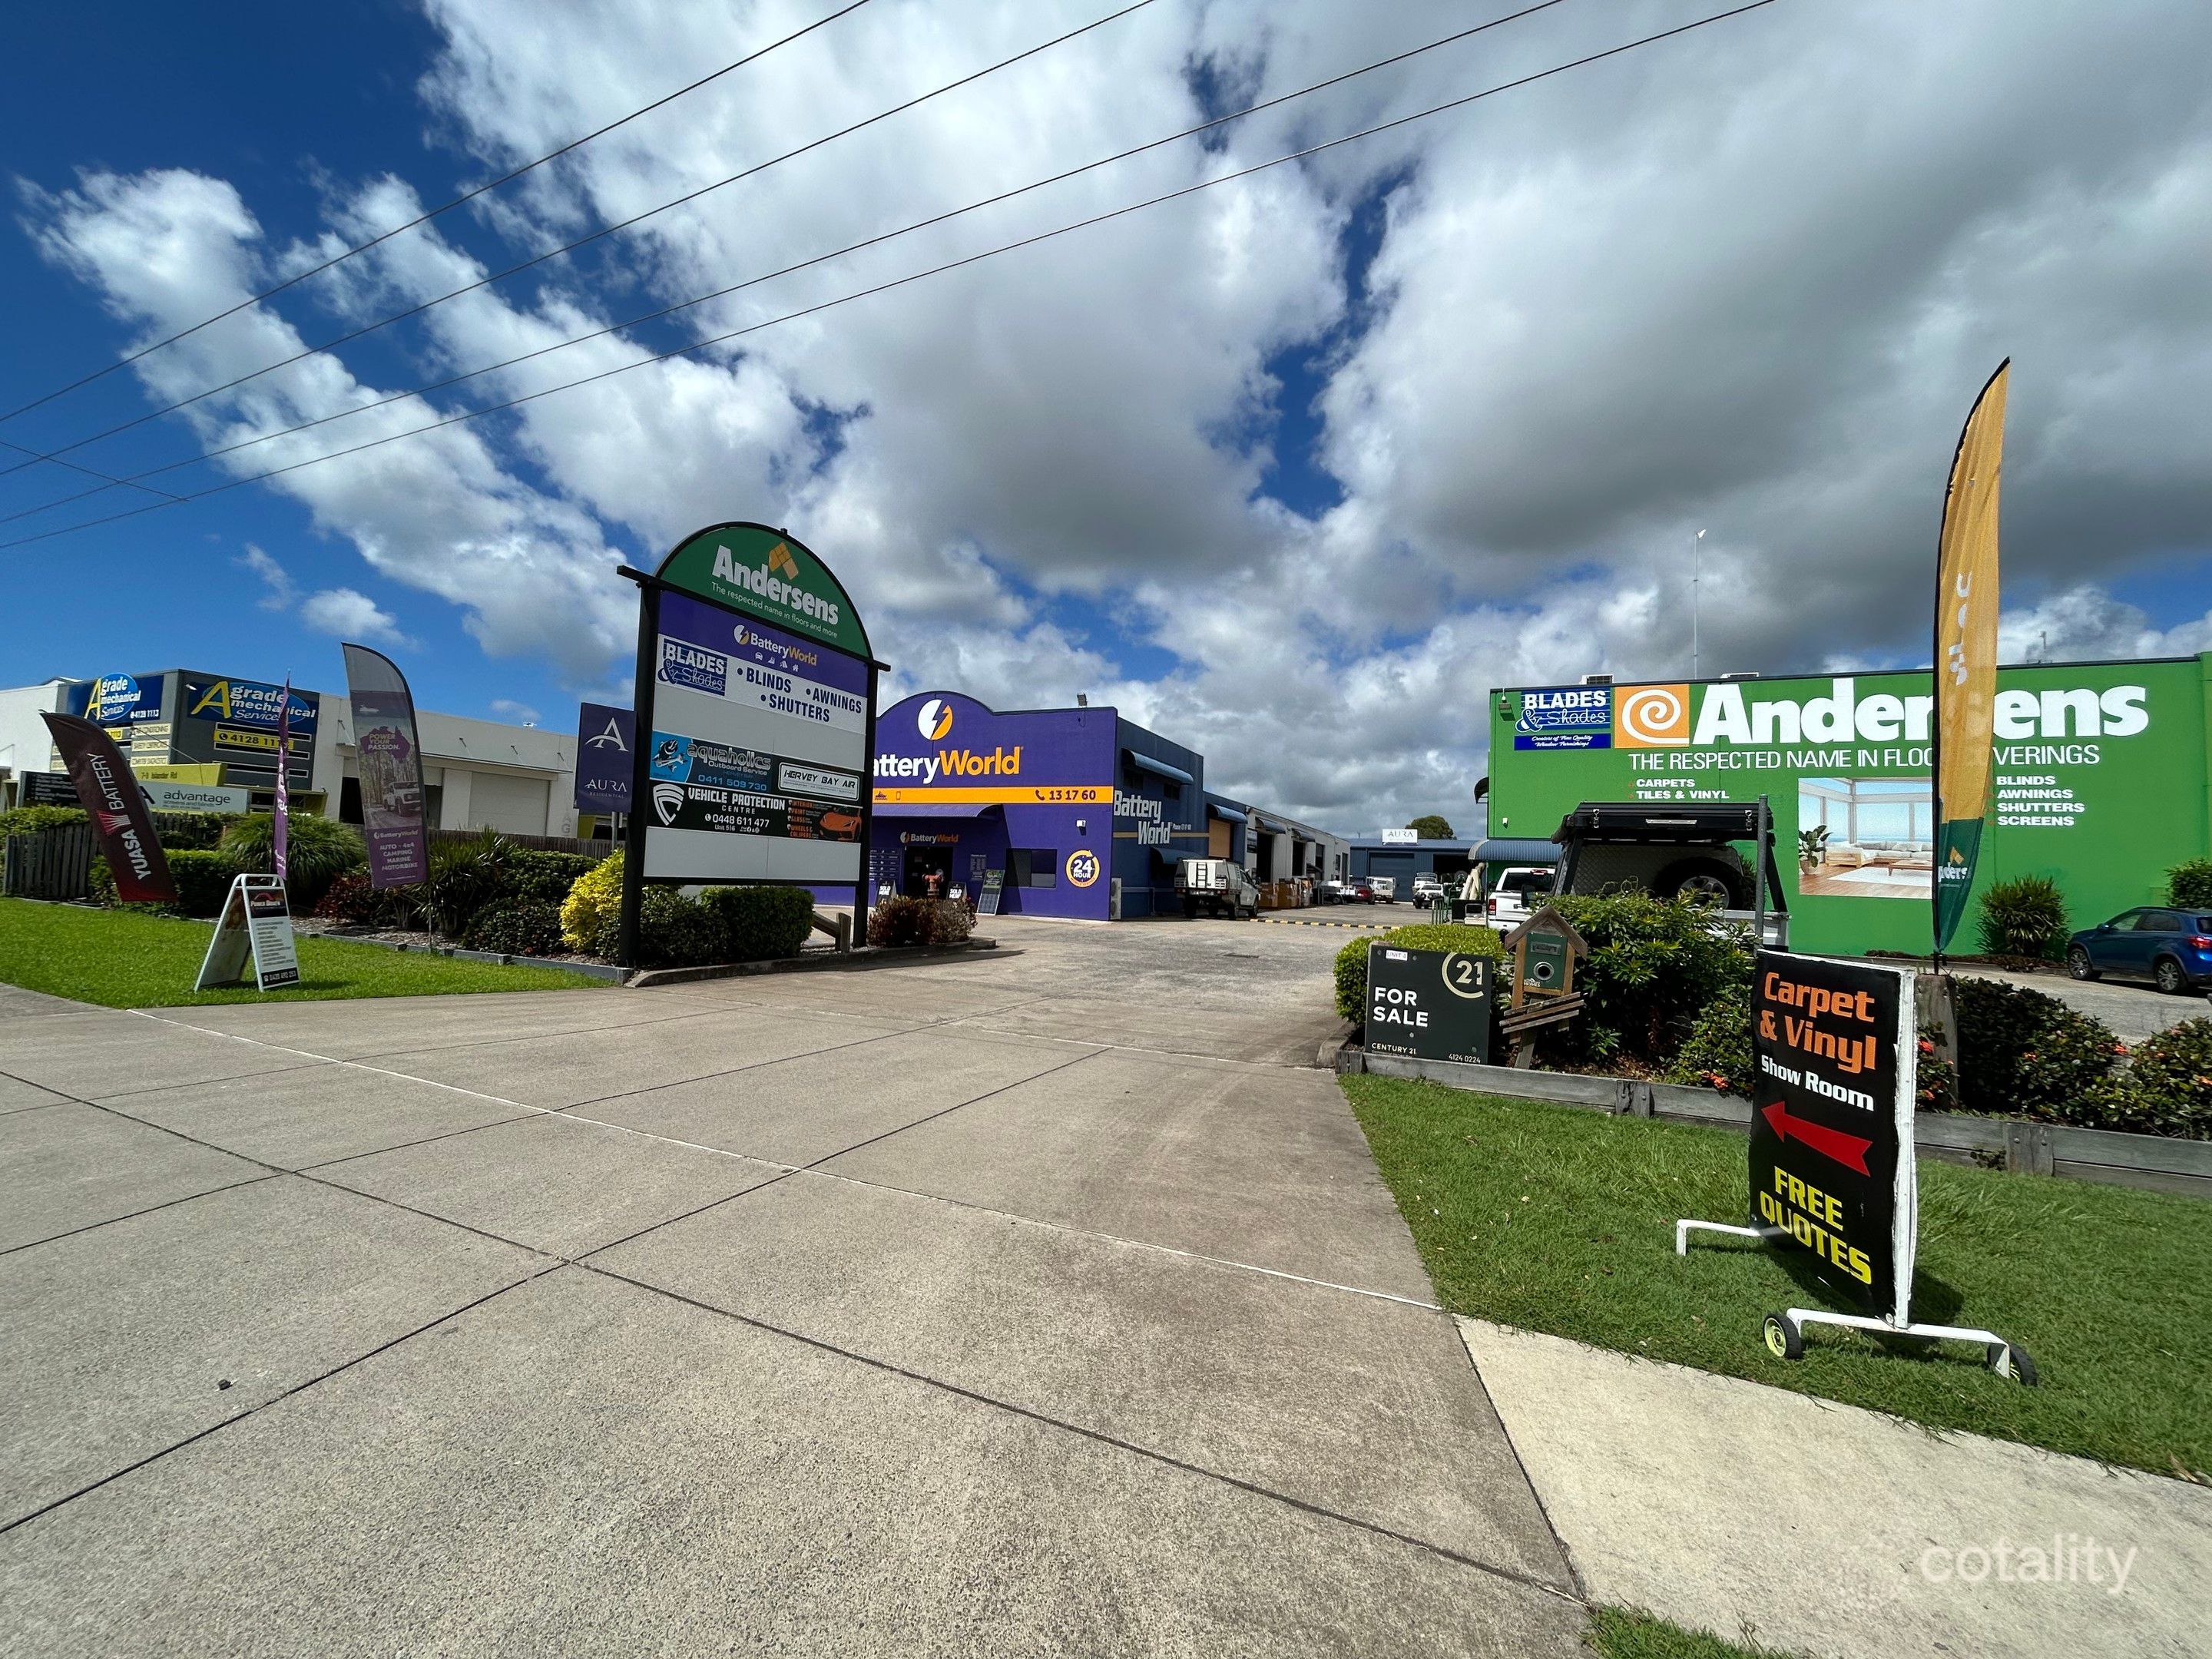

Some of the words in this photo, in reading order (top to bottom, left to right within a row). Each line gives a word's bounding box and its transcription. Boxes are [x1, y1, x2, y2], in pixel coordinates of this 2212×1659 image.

[712, 545, 839, 624] Andersens
[712, 581, 726, 594] The
[727, 591, 763, 609] respected
[764, 604, 783, 617] name
[783, 611, 790, 620] in
[791, 613, 809, 628] floors
[810, 621, 822, 632] and
[822, 628, 838, 638] more
[666, 643, 725, 675] BLADES
[101, 677, 128, 696] grade
[681, 667, 724, 690] Shades
[101, 690, 141, 704] mechanical
[230, 686, 285, 704] grade
[746, 667, 792, 693] BLINDS
[812, 687, 862, 714] AWNINGS
[1525, 690, 1607, 709] BLADES
[769, 694, 830, 722] SHUTTERS
[1692, 677, 2149, 744] Anderens
[1515, 708, 1543, 732] &
[1547, 708, 1607, 724] Shades
[231, 734, 259, 744] 4128
[687, 743, 771, 770] aquaholics
[1628, 753, 1664, 770] THE
[1670, 751, 1781, 770] RESPECTED
[1786, 749, 1851, 768] NAME
[1857, 749, 1878, 767] IN
[1884, 747, 1932, 767] FLOO
[708, 760, 742, 772] Outboard
[743, 766, 767, 776] Service
[87, 753, 124, 810] BATTERY
[584, 779, 628, 793] AURA
[698, 774, 723, 785] 0411
[727, 779, 747, 789] 509
[747, 780, 767, 791] 730
[783, 770, 818, 783] HERVEY
[821, 776, 841, 786] BAY
[842, 780, 856, 789] AIR
[1636, 779, 1696, 787] CARPETS
[1996, 776, 2056, 785] BLINDS
[164, 790, 230, 806] advantage
[688, 787, 727, 803] VEHICLE
[732, 793, 785, 810] PROTECTION
[1049, 790, 1062, 800] 13
[1065, 790, 1078, 800] 17
[1081, 790, 1096, 800] 60
[1636, 790, 1671, 800] TILES
[1675, 790, 1685, 800] &
[1690, 790, 1730, 800] VINYL
[1997, 789, 2074, 799] AWNINGS
[721, 805, 756, 815] CENTRE
[1114, 790, 1162, 824] Battery
[1997, 803, 2085, 813] SHUTTERS
[713, 814, 735, 824] 0448
[737, 816, 752, 826] 611
[754, 818, 770, 827] 477
[1997, 816, 2075, 826] SCREENS
[911, 833, 959, 844] BatteryWorld
[1137, 821, 1171, 845] World
[121, 829, 151, 880] YUASA
[1073, 859, 1094, 873] 24
[1374, 986, 1417, 1006] FOR
[1763, 971, 1876, 1023] Carpet
[1373, 1006, 1429, 1028] SALE
[1372, 1042, 1407, 1053] CENTURY
[1760, 1008, 1778, 1041] &
[1786, 1019, 1876, 1074] Vinyl
[1449, 1053, 1463, 1061] 4124
[1464, 1054, 1481, 1064] 0224
[1760, 1055, 1801, 1087] Show
[1805, 1070, 1875, 1112] Room
[1774, 1165, 1844, 1232] FREE
[1760, 1190, 1873, 1285] QUOTES
